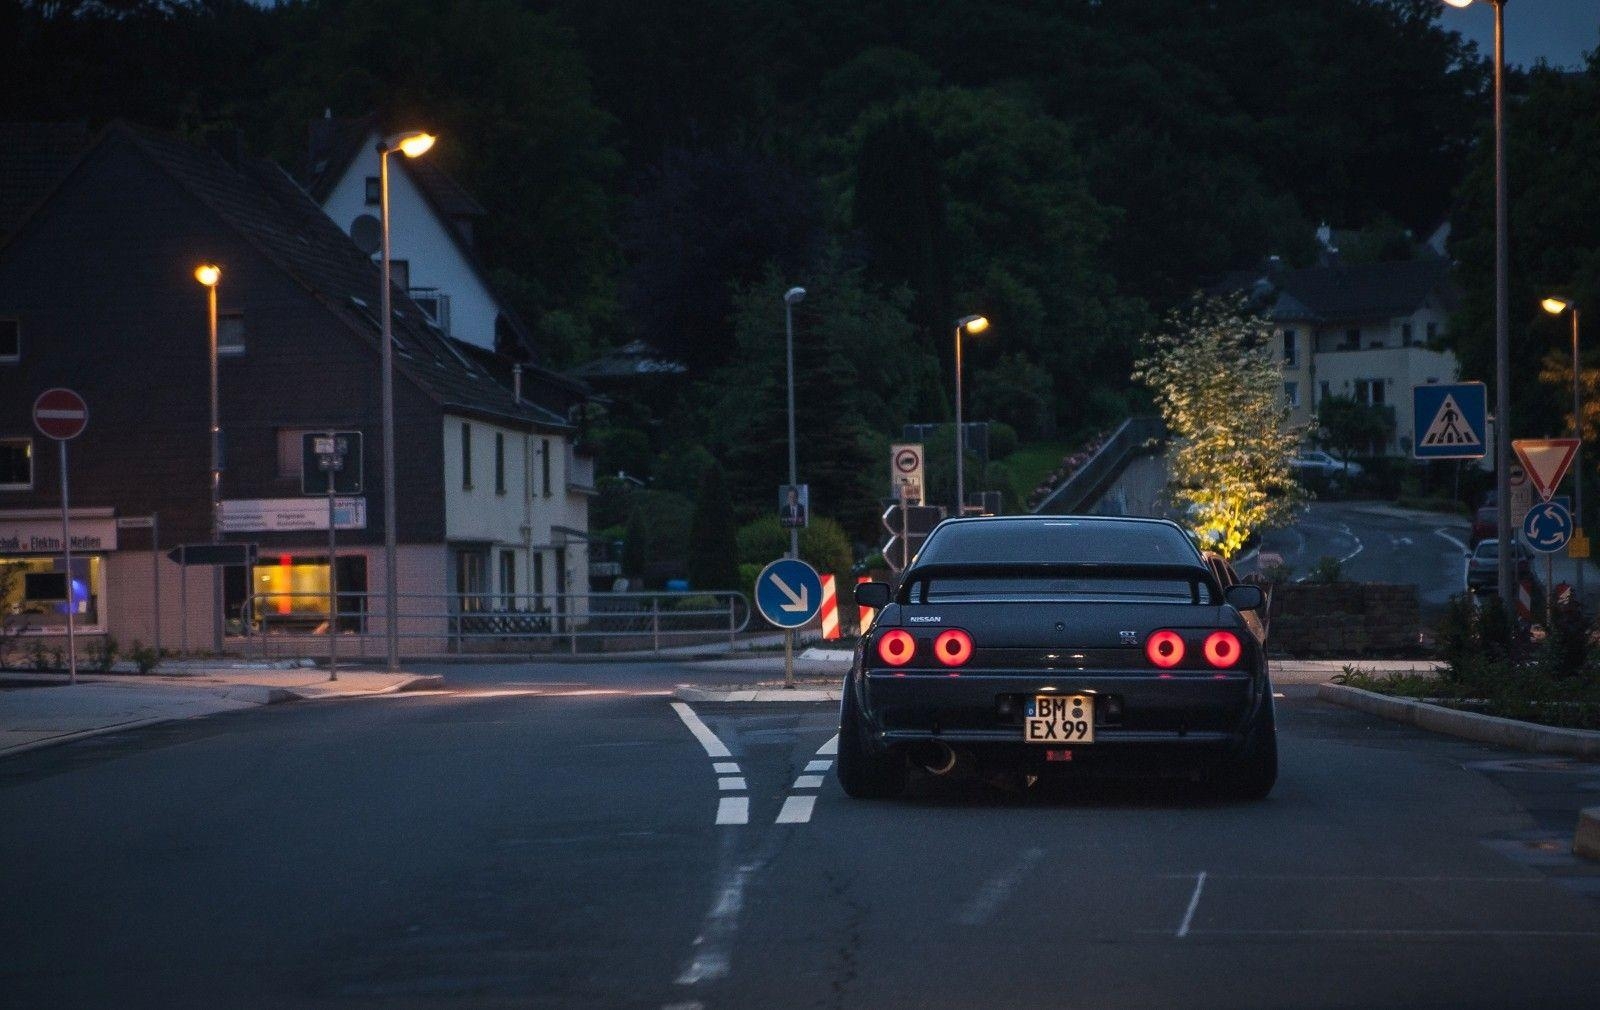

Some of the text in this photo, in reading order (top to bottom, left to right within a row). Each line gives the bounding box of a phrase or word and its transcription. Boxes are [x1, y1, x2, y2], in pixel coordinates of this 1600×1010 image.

[70, 536, 101, 548] Medien
[1038, 698, 1066, 720] BM
[1030, 720, 1088, 739] EX 99
